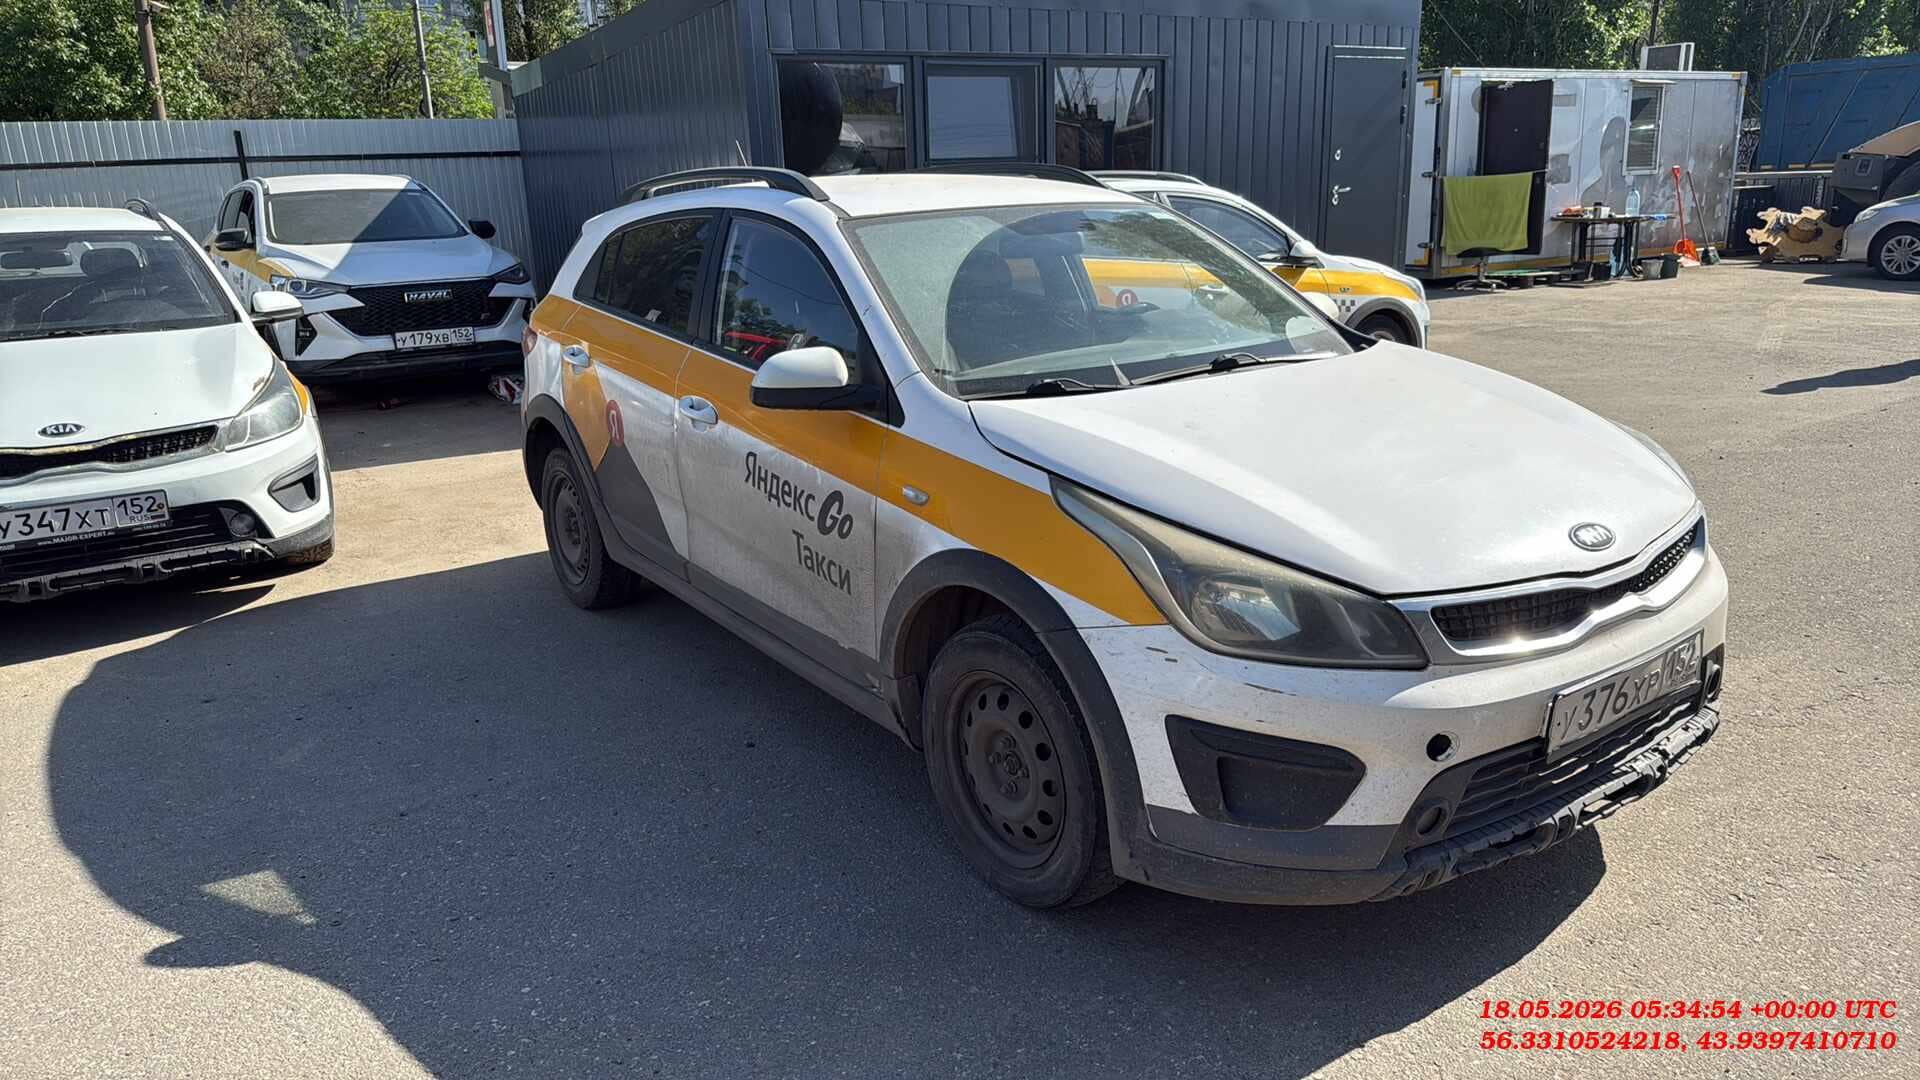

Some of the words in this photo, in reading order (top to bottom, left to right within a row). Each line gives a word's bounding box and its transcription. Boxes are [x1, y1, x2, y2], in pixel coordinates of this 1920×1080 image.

[408, 289, 449, 301] HAVAL
[401, 332, 449, 346] У179ХВ
[452, 328, 470, 338] 152
[47, 424, 78, 434] KIA
[744, 451, 815, 522] Яндекс
[816, 490, 854, 540] Go
[0, 508, 108, 539] У347ХТ
[117, 496, 158, 516] 152
[129, 514, 150, 523] RUS
[792, 529, 852, 595] Такси
[1560, 669, 1663, 740] У376ХР
